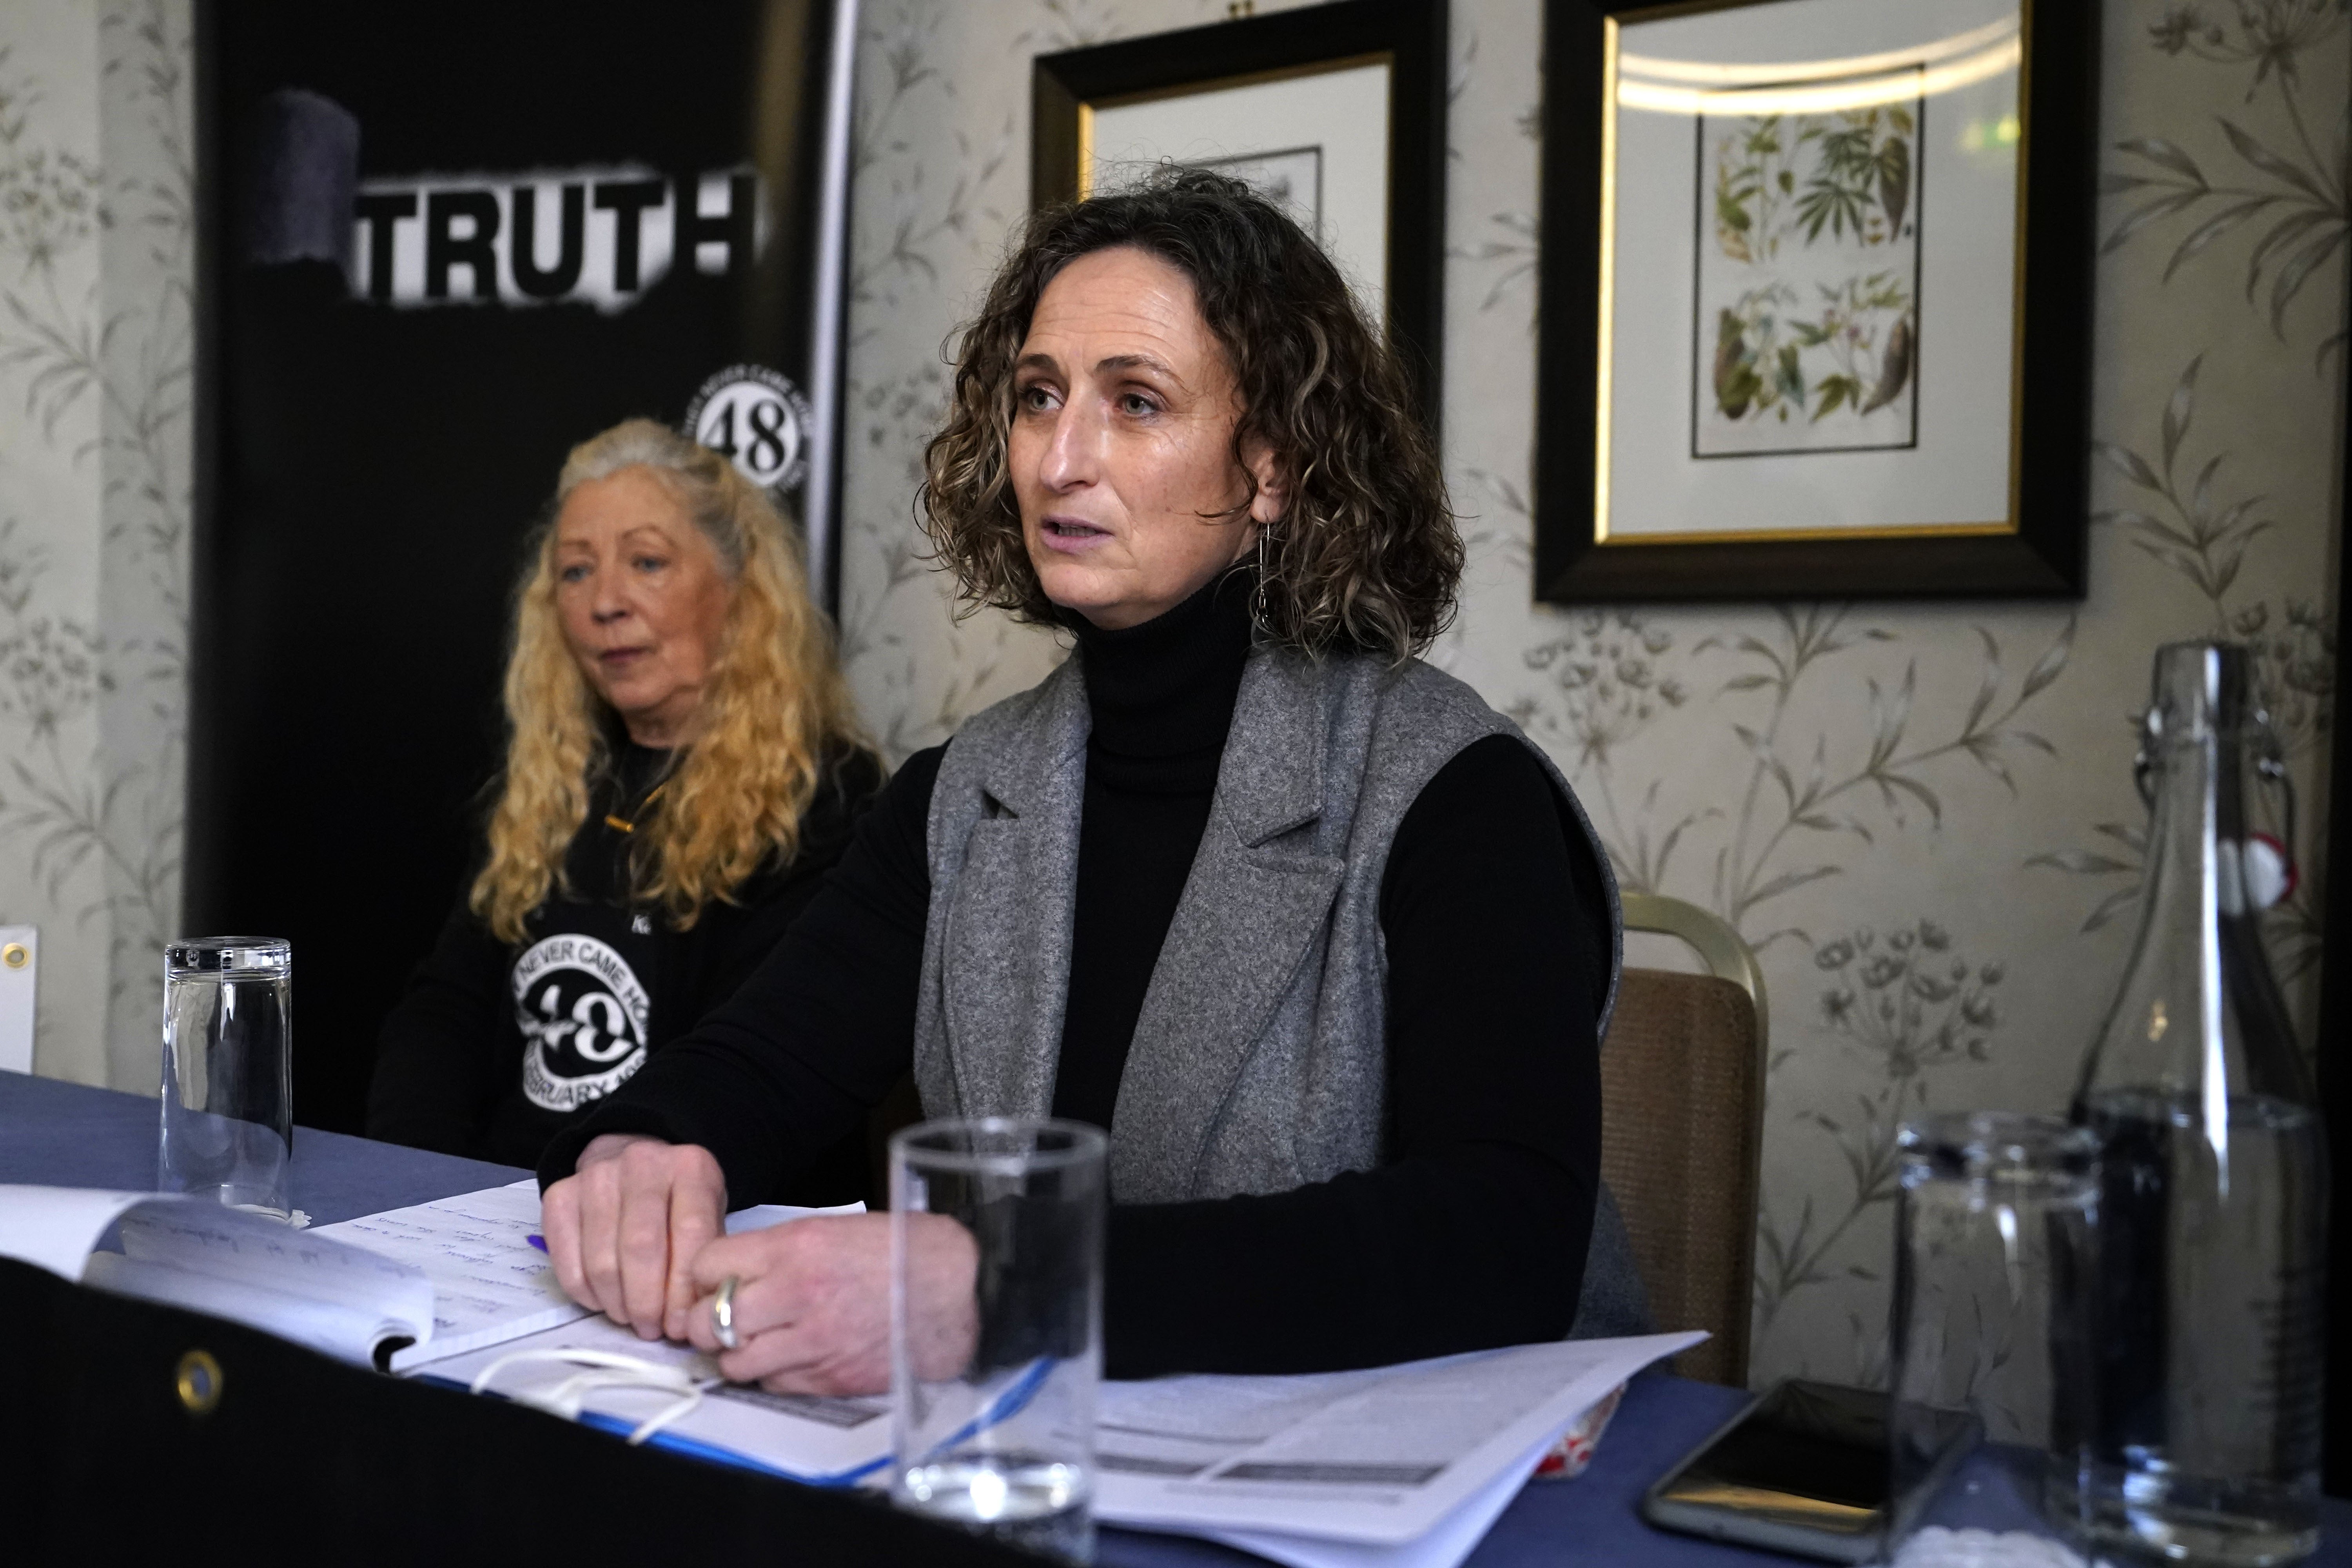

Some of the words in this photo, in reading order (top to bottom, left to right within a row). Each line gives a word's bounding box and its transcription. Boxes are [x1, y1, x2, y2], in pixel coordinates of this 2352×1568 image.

[355, 176, 756, 297] TRUTH
[704, 397, 786, 472] 48
[516, 941, 574, 978] NEVER
[579, 942, 626, 987] CAME
